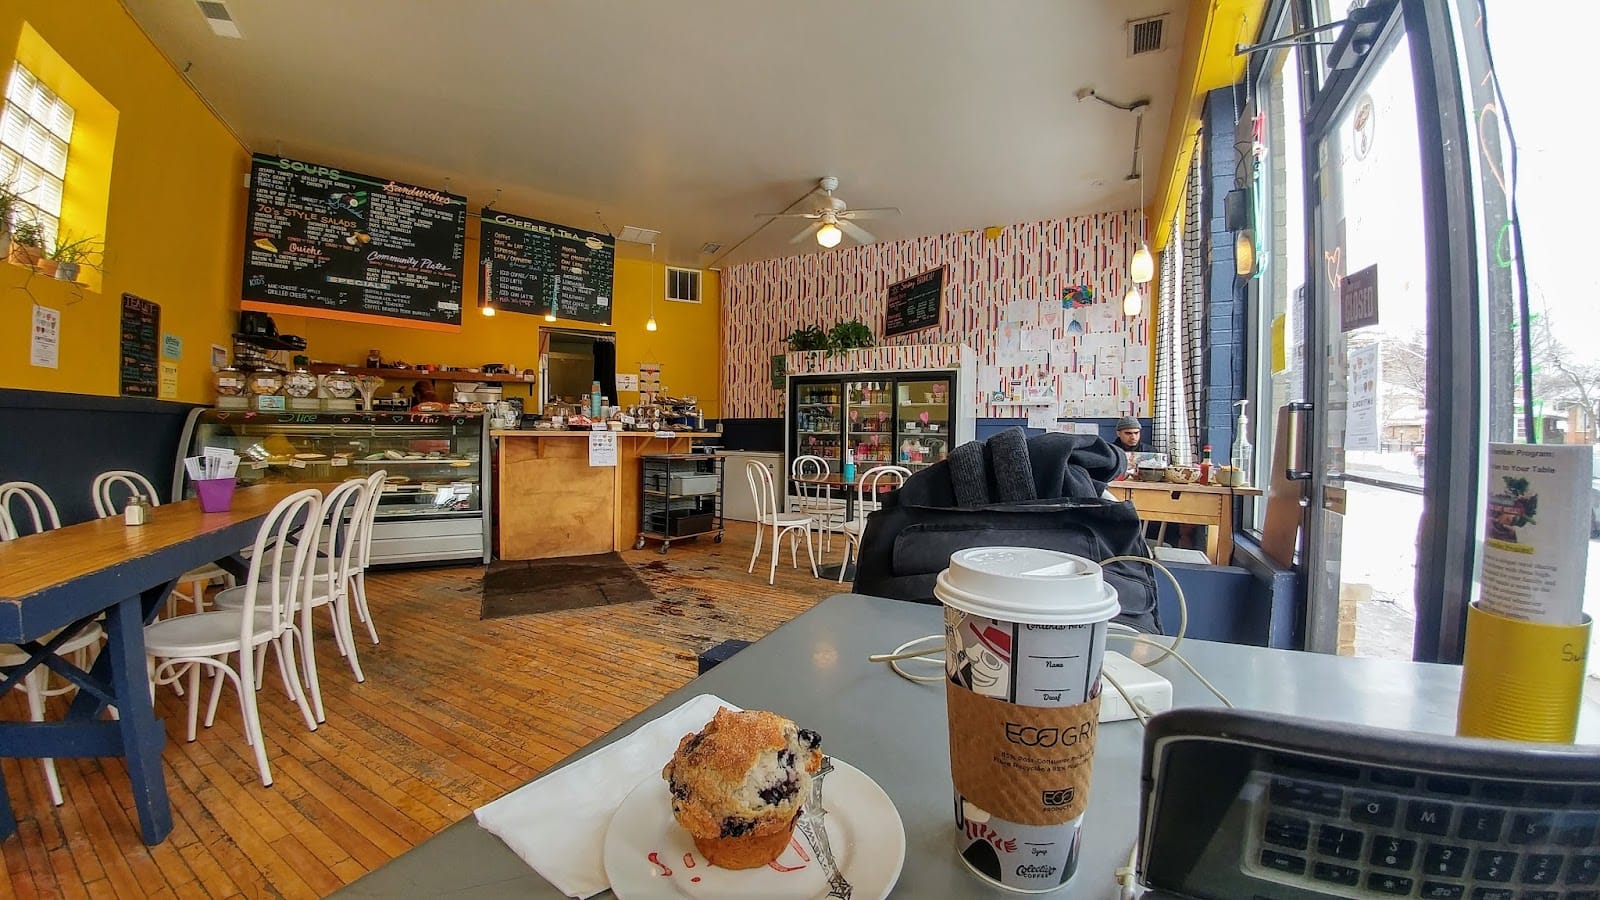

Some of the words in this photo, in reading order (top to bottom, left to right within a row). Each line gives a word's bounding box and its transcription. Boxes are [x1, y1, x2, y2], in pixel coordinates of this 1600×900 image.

[279, 158, 341, 181] SOUPS
[383, 181, 450, 204] Sandwiches
[284, 208, 318, 220] STYLE
[320, 214, 357, 228] SALADS
[495, 215, 548, 234] COFFEE
[557, 229, 580, 240] TEA
[289, 242, 323, 256] Quiche
[366, 251, 418, 268] Community
[326, 275, 391, 291] SPECIALS
[268, 288, 289, 297] GRILLED
[1345, 286, 1374, 323] CLOSED
[1533, 466, 1556, 476] Table
[1046, 660, 1065, 669] Name
[1043, 693, 1062, 702] Decaf
[1042, 787, 1075, 806] ECO
